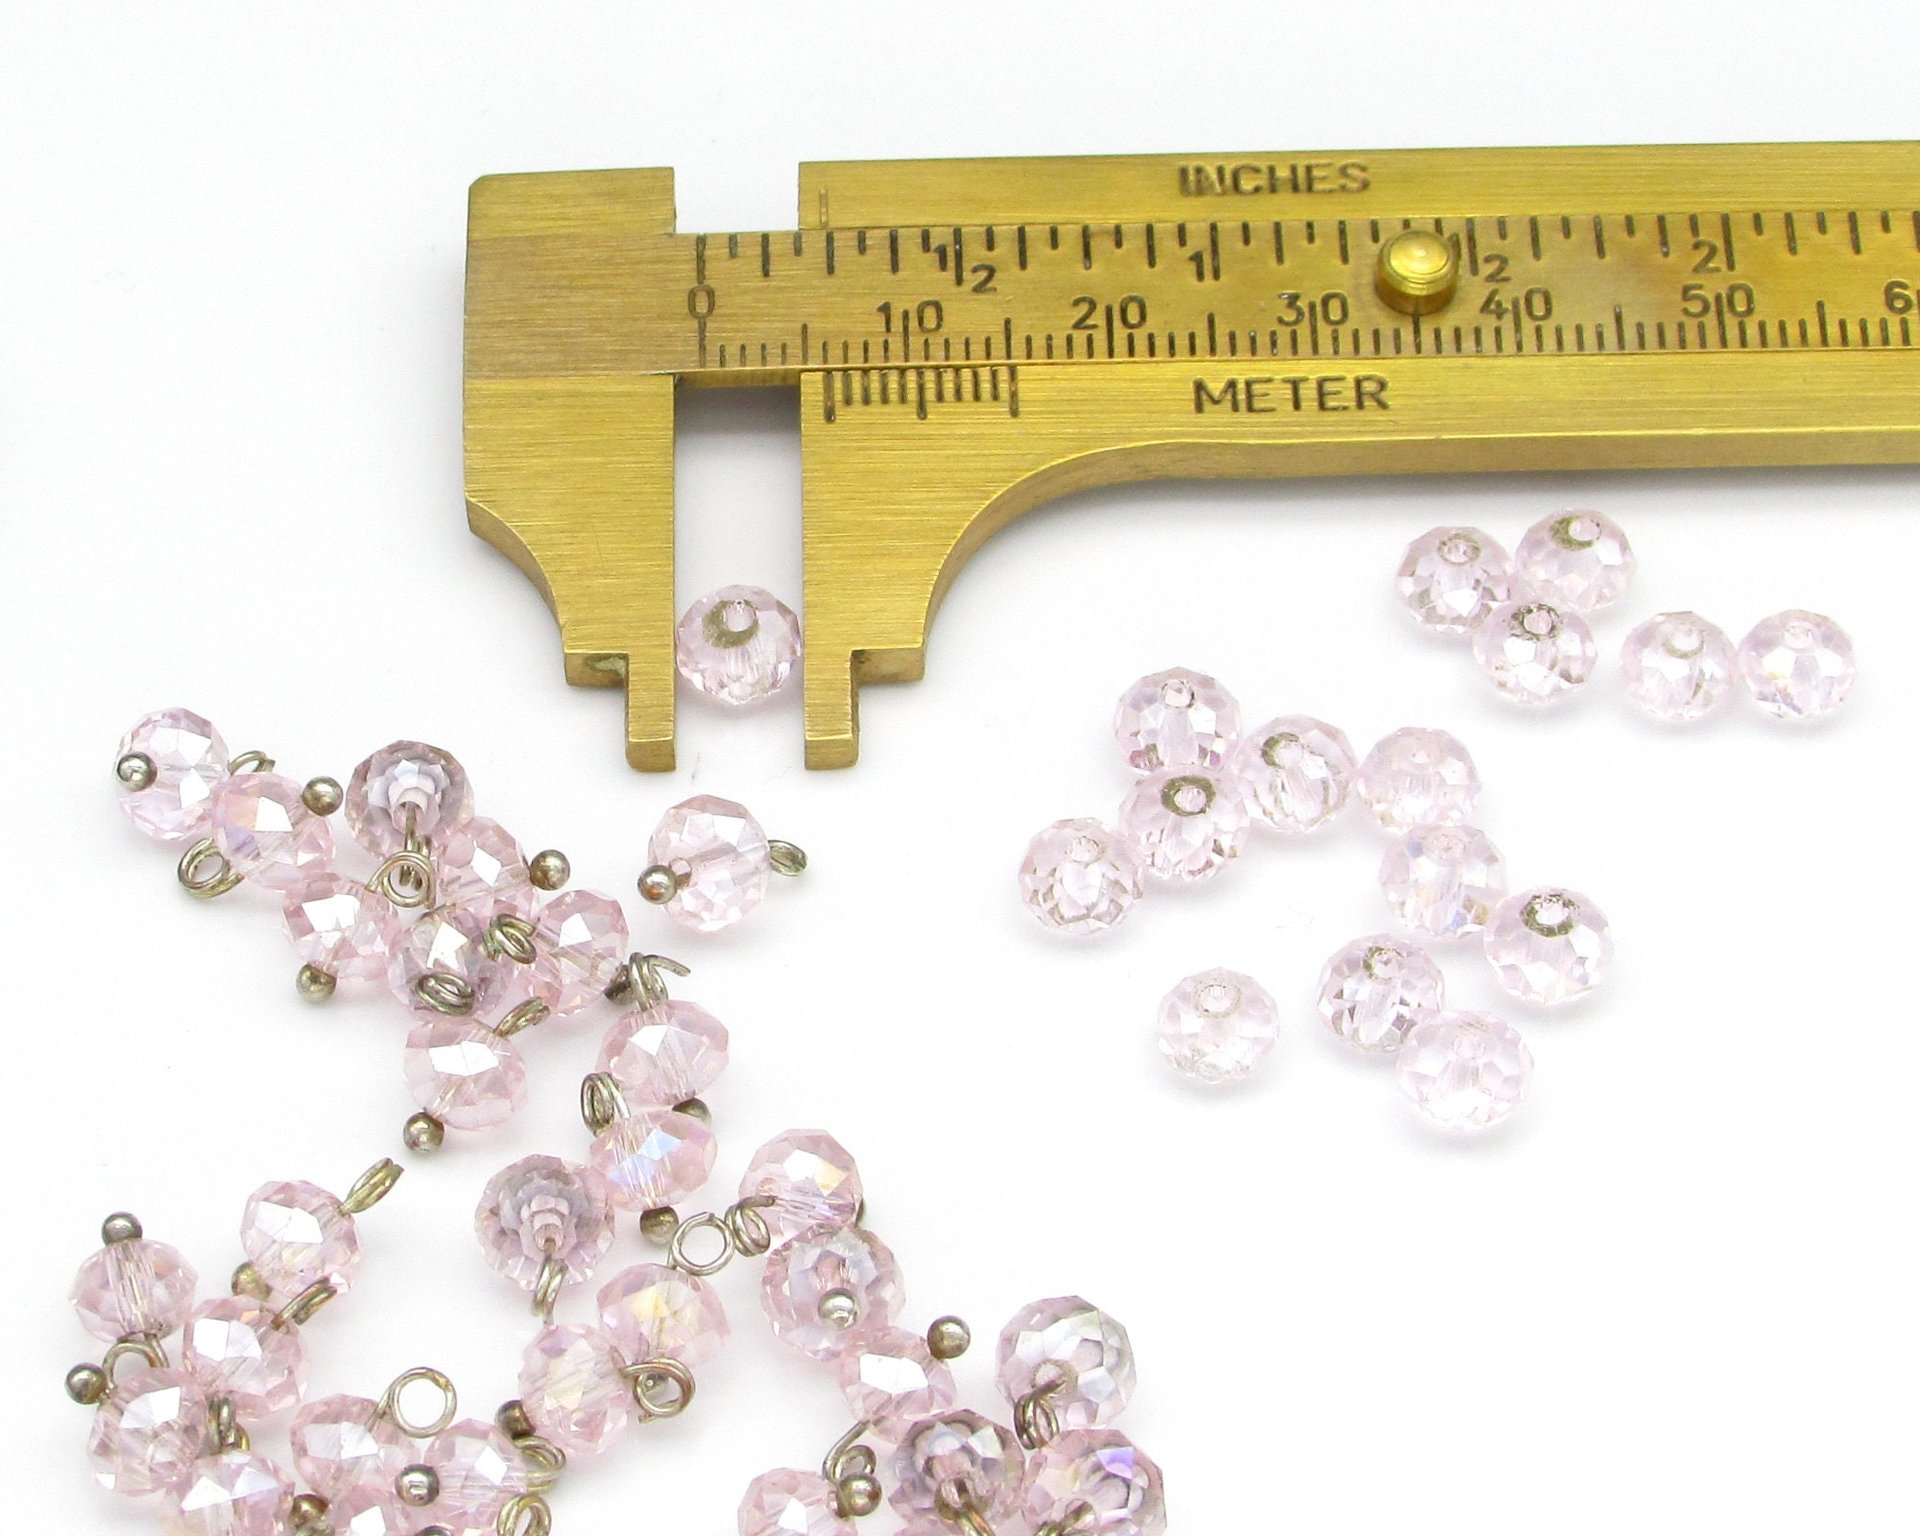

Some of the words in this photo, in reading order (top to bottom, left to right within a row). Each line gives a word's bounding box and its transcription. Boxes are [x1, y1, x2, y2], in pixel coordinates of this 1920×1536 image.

[1178, 161, 1371, 196] INCHES
[1188, 250, 1205, 283] 1
[1691, 239, 1722, 274] 2
[687, 284, 716, 320] 0
[1072, 295, 1148, 330] 20
[1276, 291, 1350, 326] 30
[1480, 287, 1553, 322] 40
[1681, 282, 1755, 319] 50
[1192, 373, 1390, 414] METER
